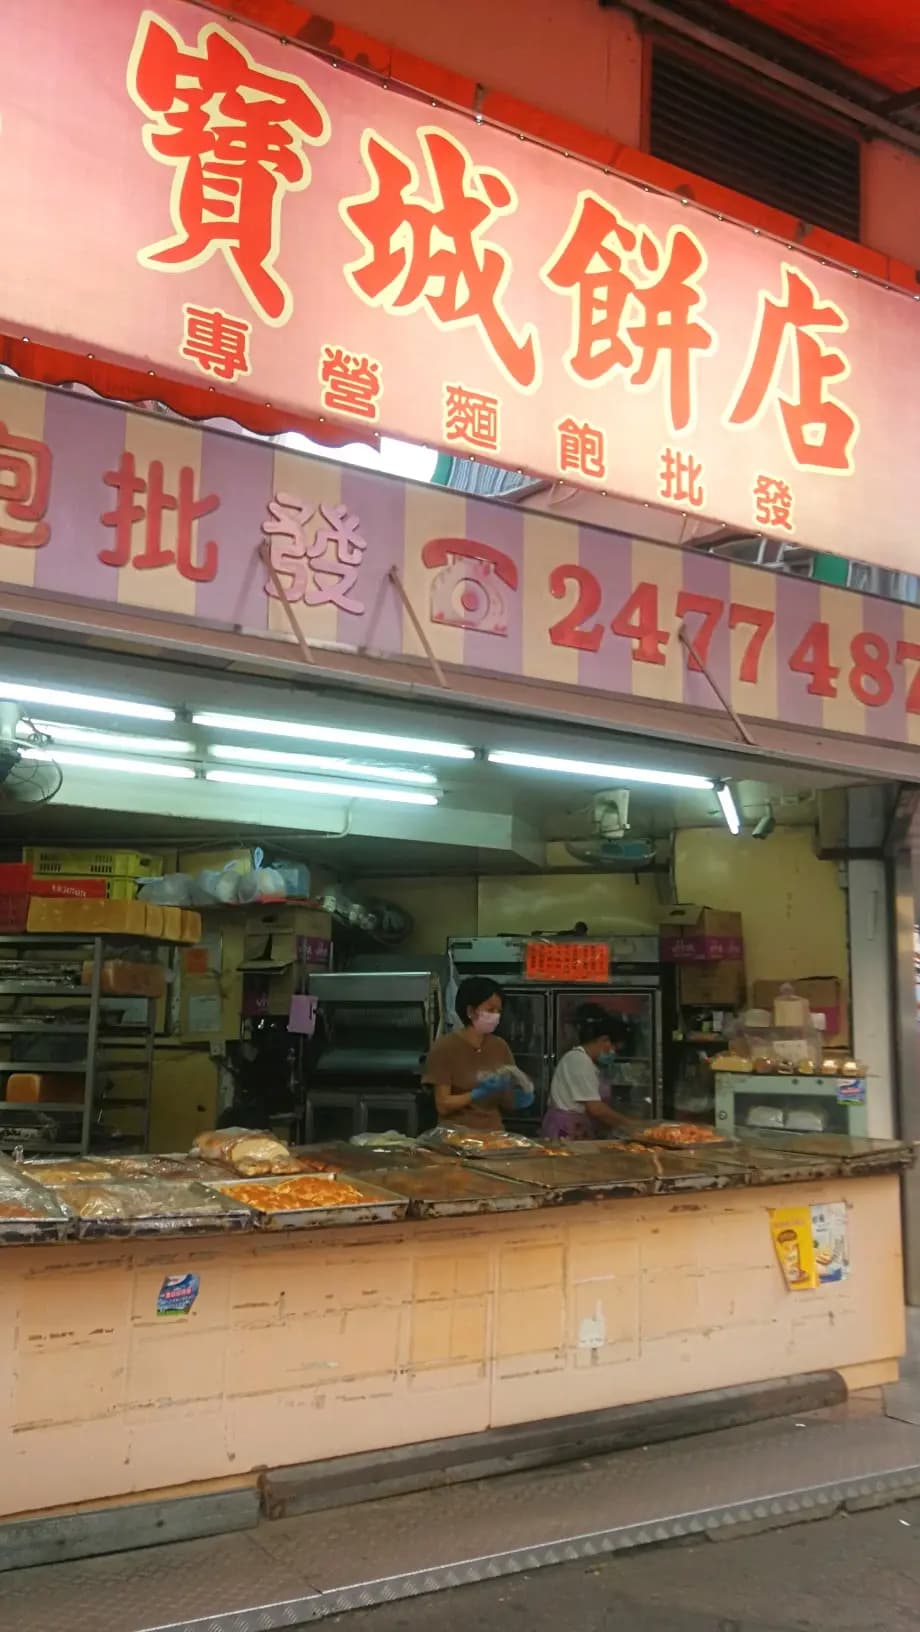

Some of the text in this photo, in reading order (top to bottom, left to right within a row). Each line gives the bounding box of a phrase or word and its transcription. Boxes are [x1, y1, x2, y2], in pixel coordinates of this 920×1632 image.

[129, 12, 857, 471] 寶城餅店
[181, 304, 794, 531] 專營麵飽批發
